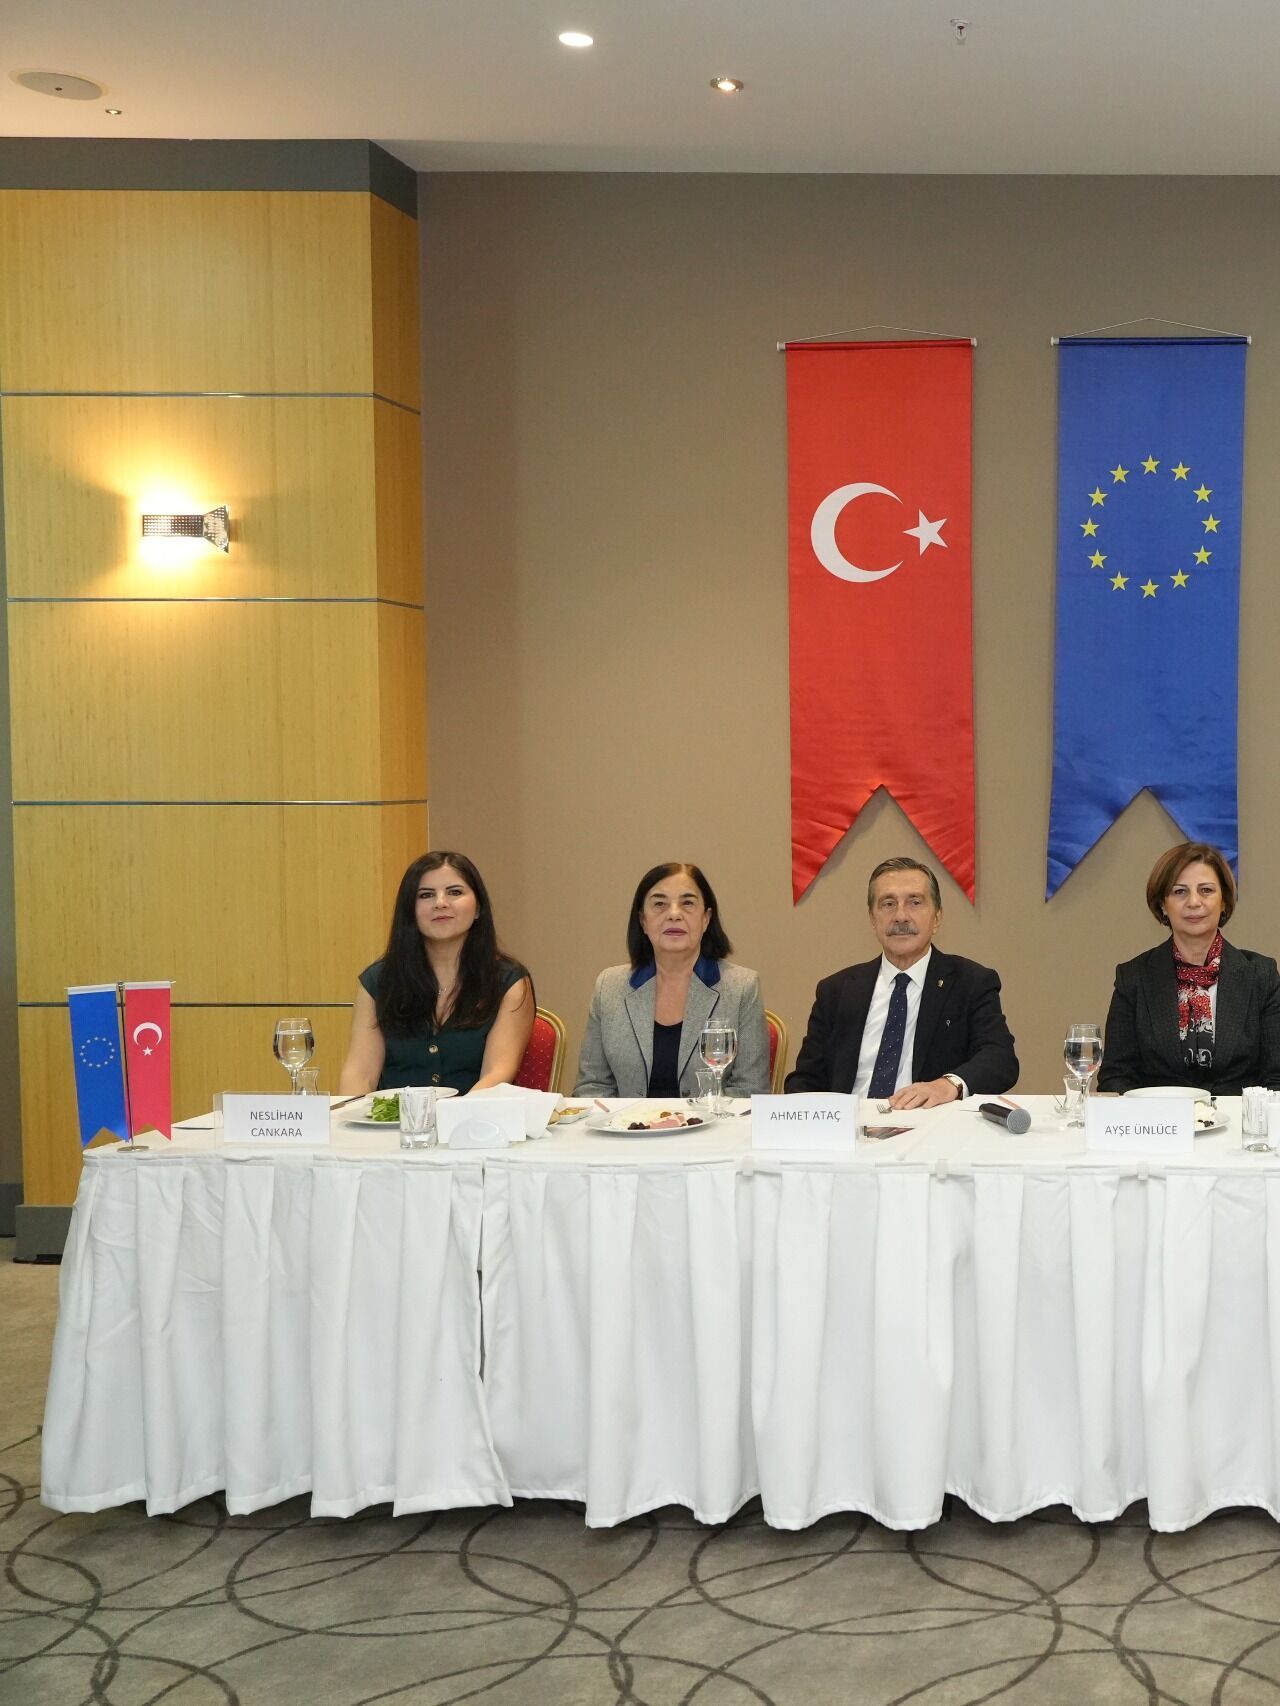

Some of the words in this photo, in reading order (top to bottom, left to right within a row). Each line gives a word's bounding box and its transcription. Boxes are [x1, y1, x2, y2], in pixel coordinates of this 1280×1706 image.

[250, 1108, 303, 1121] NESLİHAN
[770, 1110, 810, 1121] AHMET
[812, 1110, 841, 1123] ATAÇ
[250, 1127, 303, 1137] CANKARA
[1104, 1125, 1131, 1136] AYŞE
[1134, 1123, 1178, 1135] ÜNLÜCE
